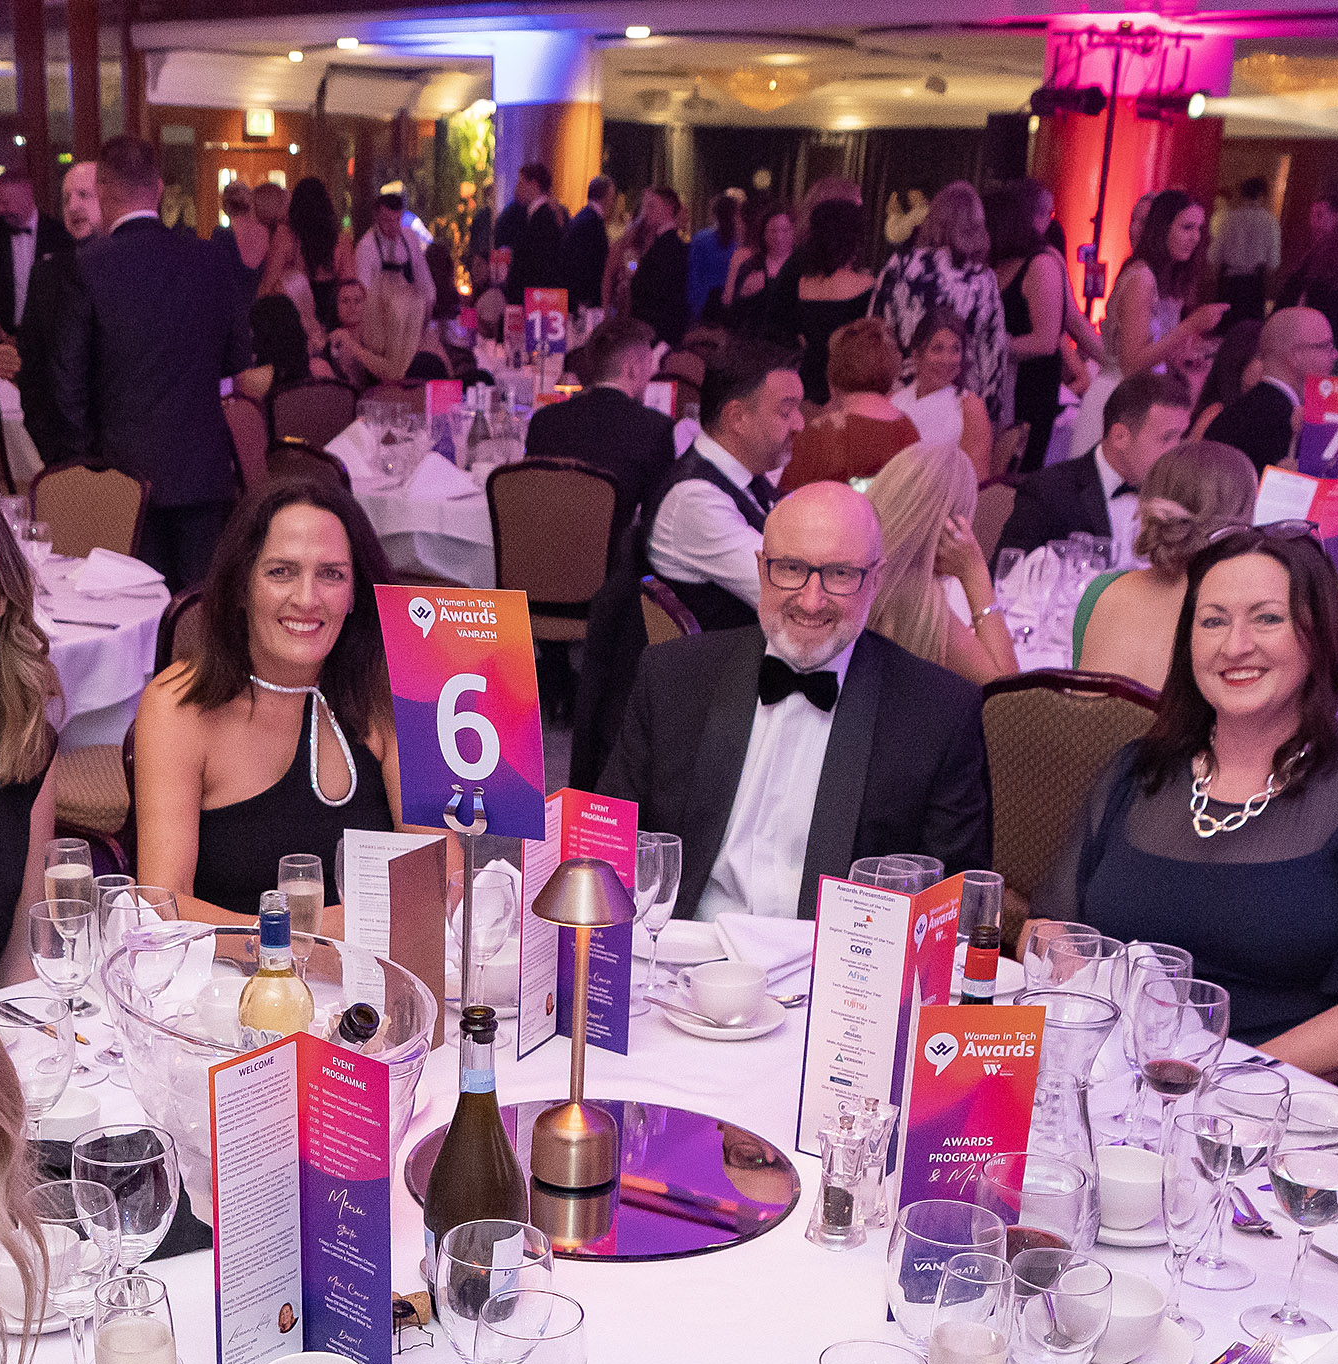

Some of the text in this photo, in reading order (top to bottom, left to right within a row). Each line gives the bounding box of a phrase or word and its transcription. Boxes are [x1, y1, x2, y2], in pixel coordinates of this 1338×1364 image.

[527, 310, 565, 342] 13
[436, 597, 496, 609] Women in Tech
[439, 606, 498, 626] Awards
[456, 628, 498, 641] VANRATH
[437, 673, 501, 782] 6
[837, 885, 895, 903] Awards Presentation
[928, 907, 958, 931] Awards
[850, 944, 872, 956] core
[964, 1031, 1037, 1041] Women in Tech
[962, 1041, 1036, 1057] Awards
[238, 1056, 275, 1077] WELCOME
[332, 1056, 355, 1073] EVENT
[322, 1066, 367, 1092] PROGRAMME
[942, 1136, 994, 1147] AWARDS
[928, 1168, 941, 1183] &
[328, 1189, 366, 1219] Menu
